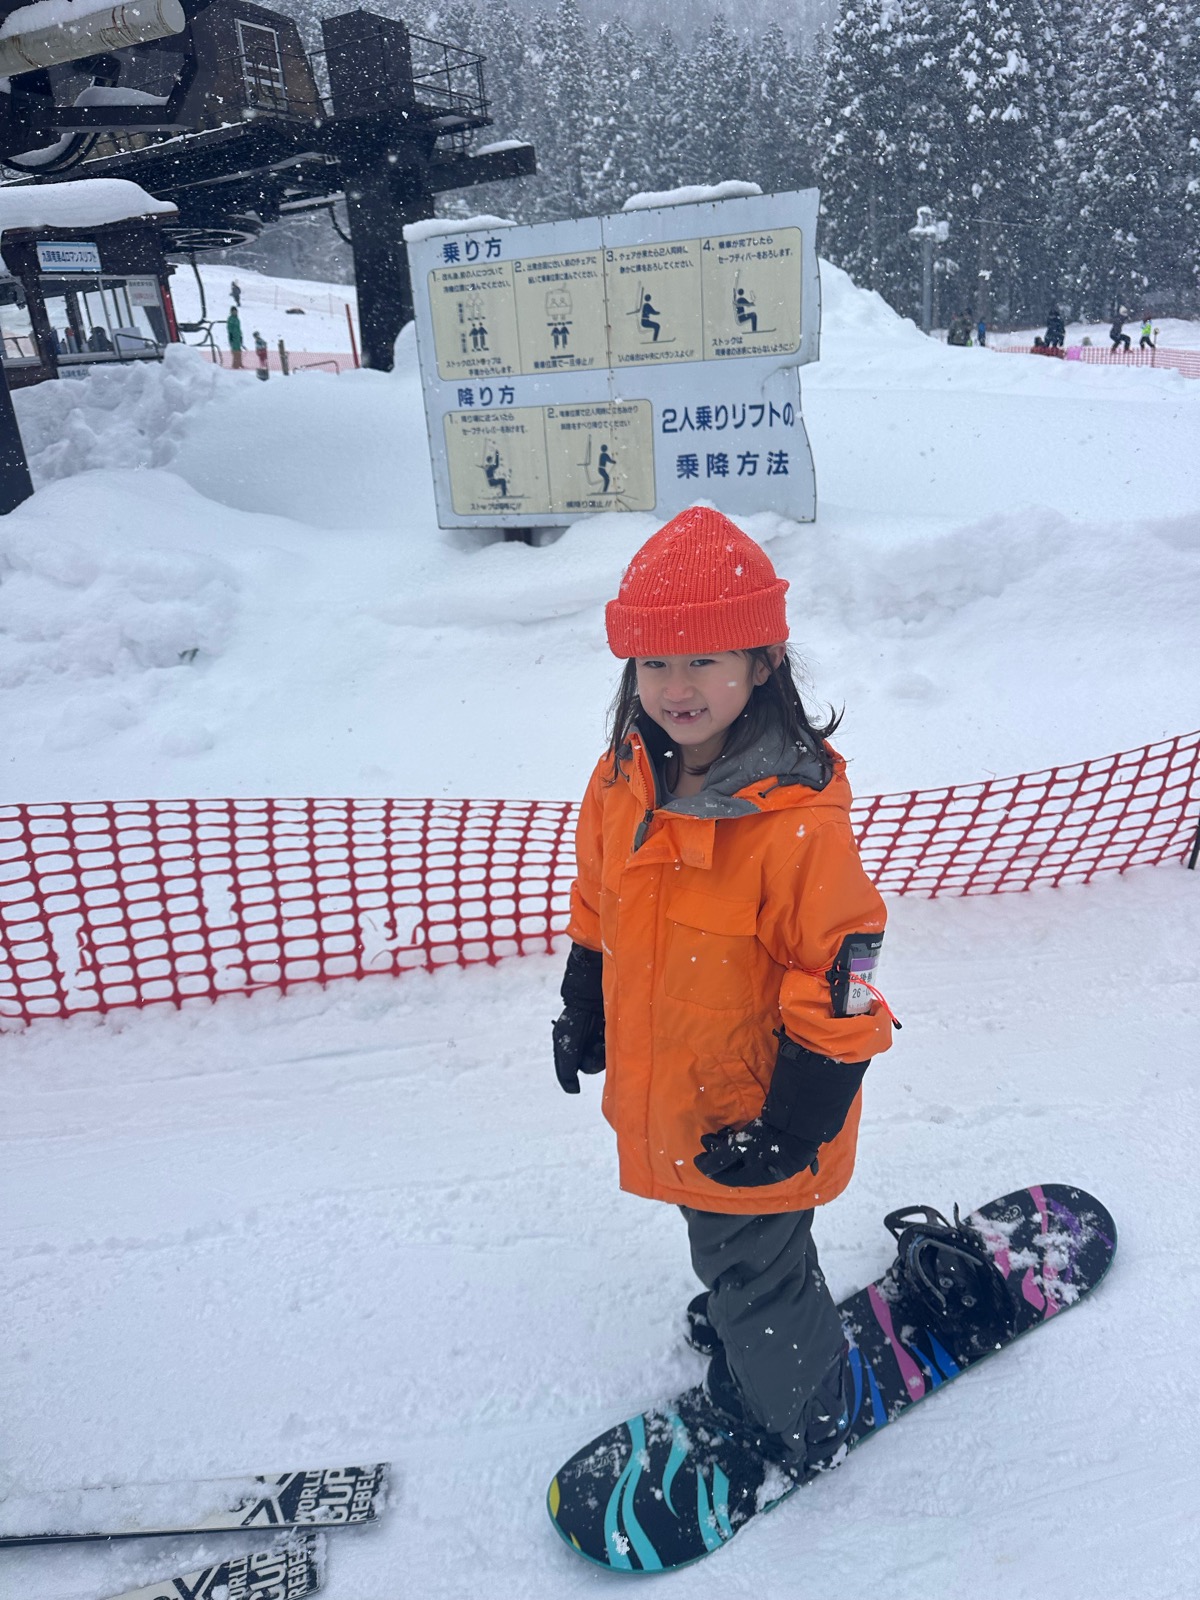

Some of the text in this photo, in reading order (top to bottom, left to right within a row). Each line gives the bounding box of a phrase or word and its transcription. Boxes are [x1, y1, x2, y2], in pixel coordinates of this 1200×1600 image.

[442, 237, 502, 264] 乗り方
[457, 386, 515, 407] 降り方
[662, 401, 795, 434] 2人乗りリフトの
[676, 449, 789, 479] 乗降方法
